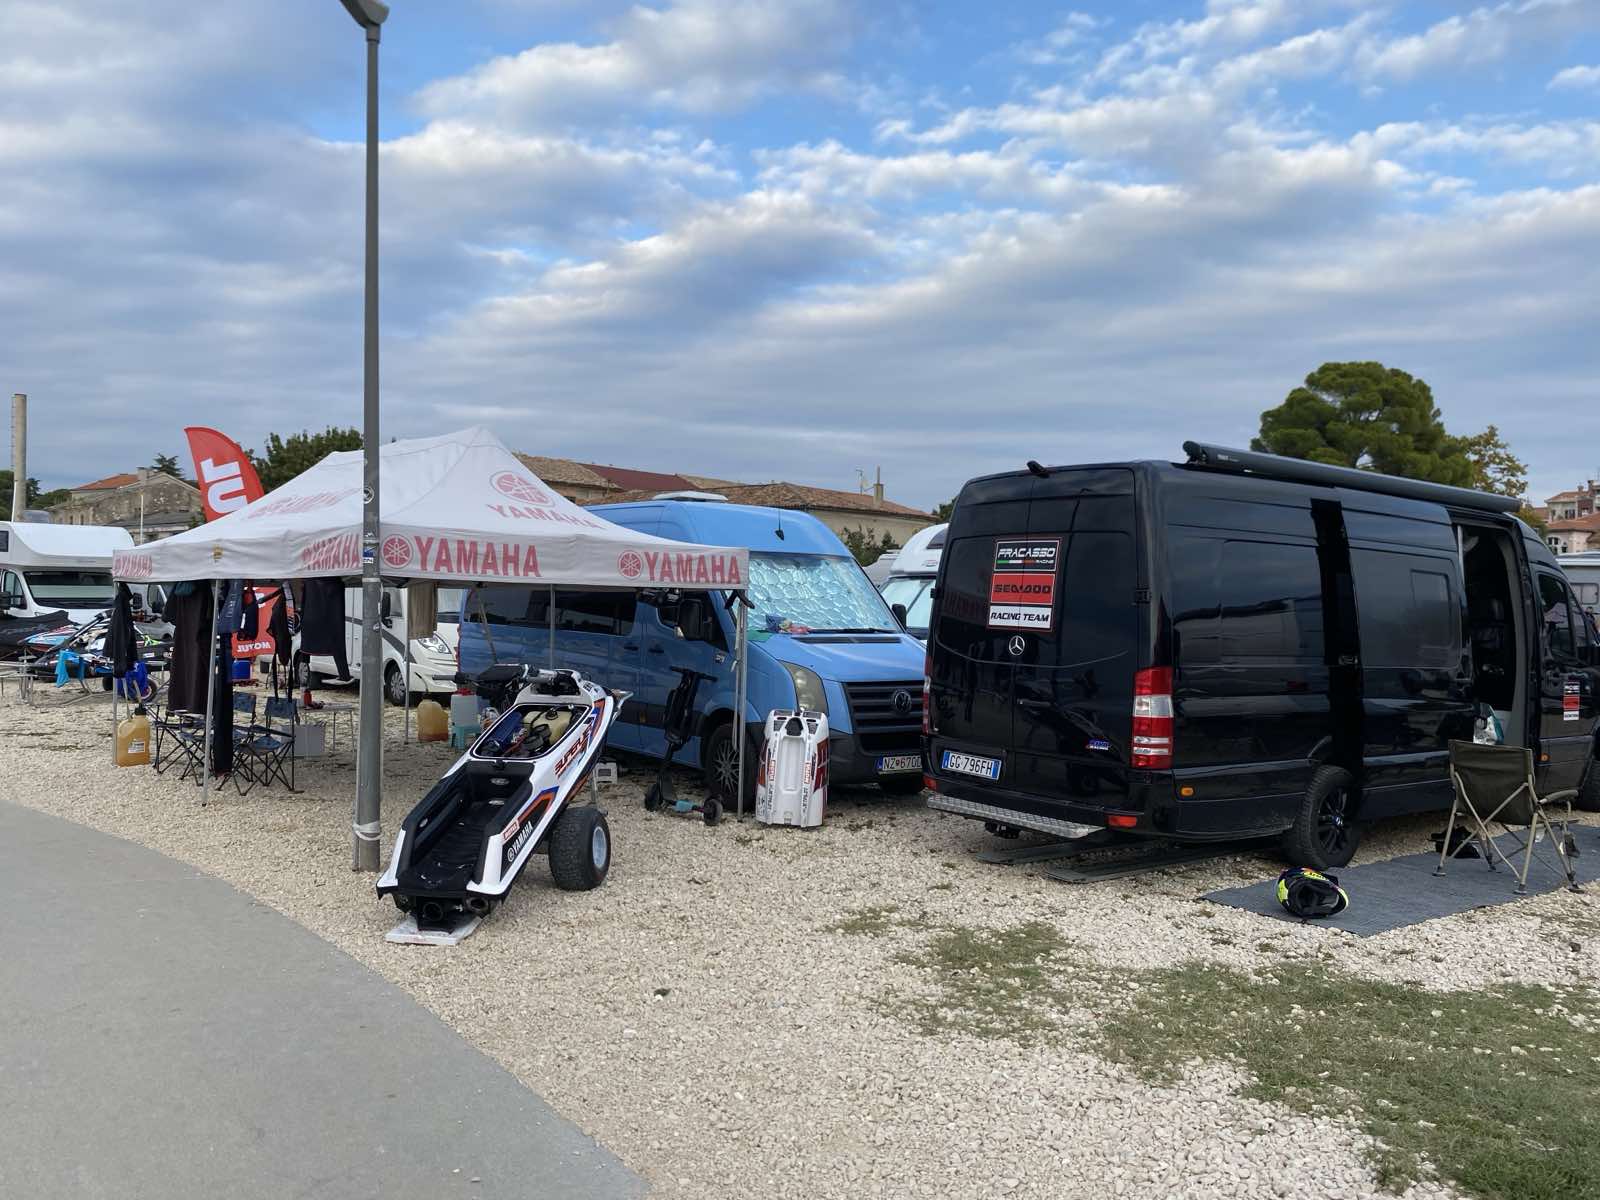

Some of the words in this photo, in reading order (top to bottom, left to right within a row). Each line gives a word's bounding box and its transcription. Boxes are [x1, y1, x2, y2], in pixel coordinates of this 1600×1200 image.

[485, 503, 607, 530] YAMAHA
[414, 535, 542, 577] YAMAHA
[997, 547, 1056, 558] FRACASSO
[643, 551, 740, 584] YAMAHA
[991, 612, 1021, 621] RACING
[1023, 613, 1050, 622] TEAM
